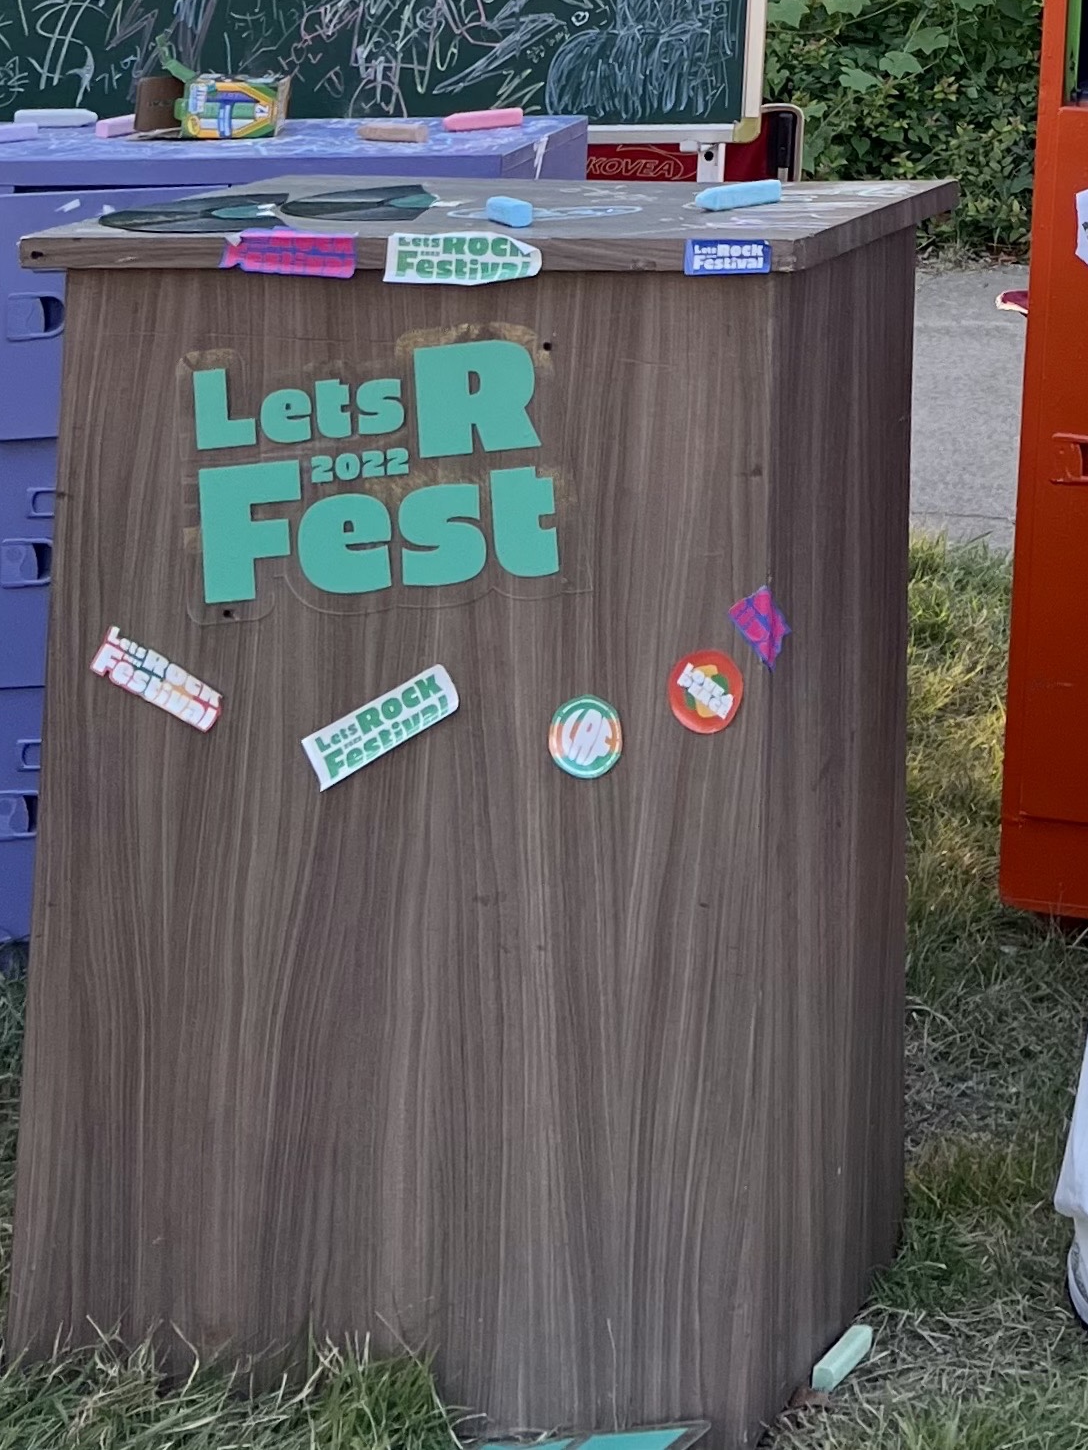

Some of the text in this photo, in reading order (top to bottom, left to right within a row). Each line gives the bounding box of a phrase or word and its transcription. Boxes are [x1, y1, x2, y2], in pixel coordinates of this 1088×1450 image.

[586, 156, 675, 178] KOVEA
[395, 249, 532, 280] Festival
[692, 254, 764, 270] Festival
[193, 339, 542, 458] Lets R
[311, 447, 409, 483] 2022
[198, 459, 560, 604] Fest
[92, 642, 218, 731] Festival
[314, 723, 359, 753] Lets
[323, 694, 449, 780] Festival
